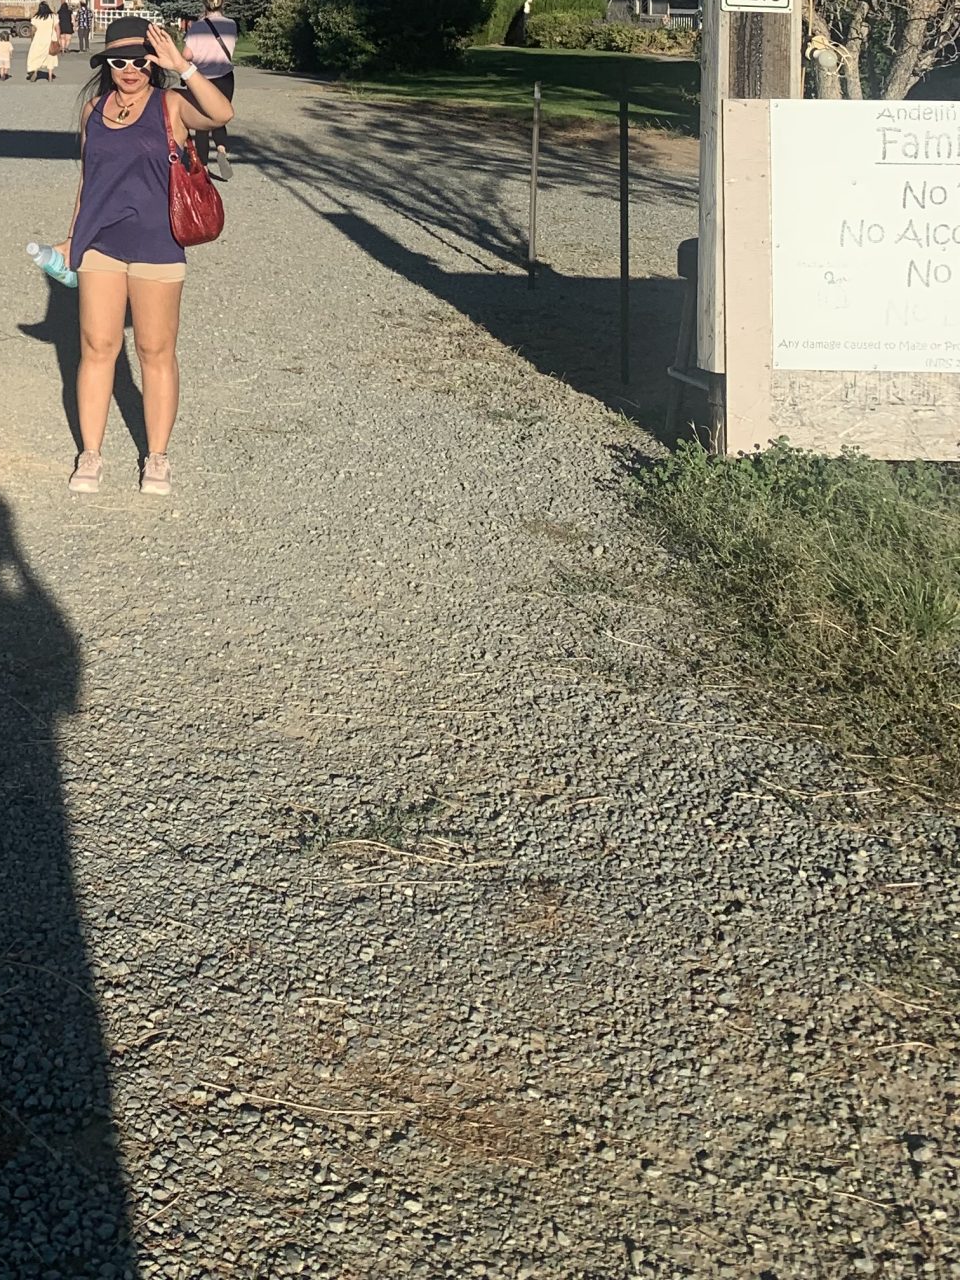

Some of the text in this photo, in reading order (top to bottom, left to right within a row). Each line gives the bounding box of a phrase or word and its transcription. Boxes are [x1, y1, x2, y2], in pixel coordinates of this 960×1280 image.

[902, 180, 948, 209] No
[840, 219, 885, 247] No
[907, 258, 952, 288] No
[778, 338, 800, 350] Any
